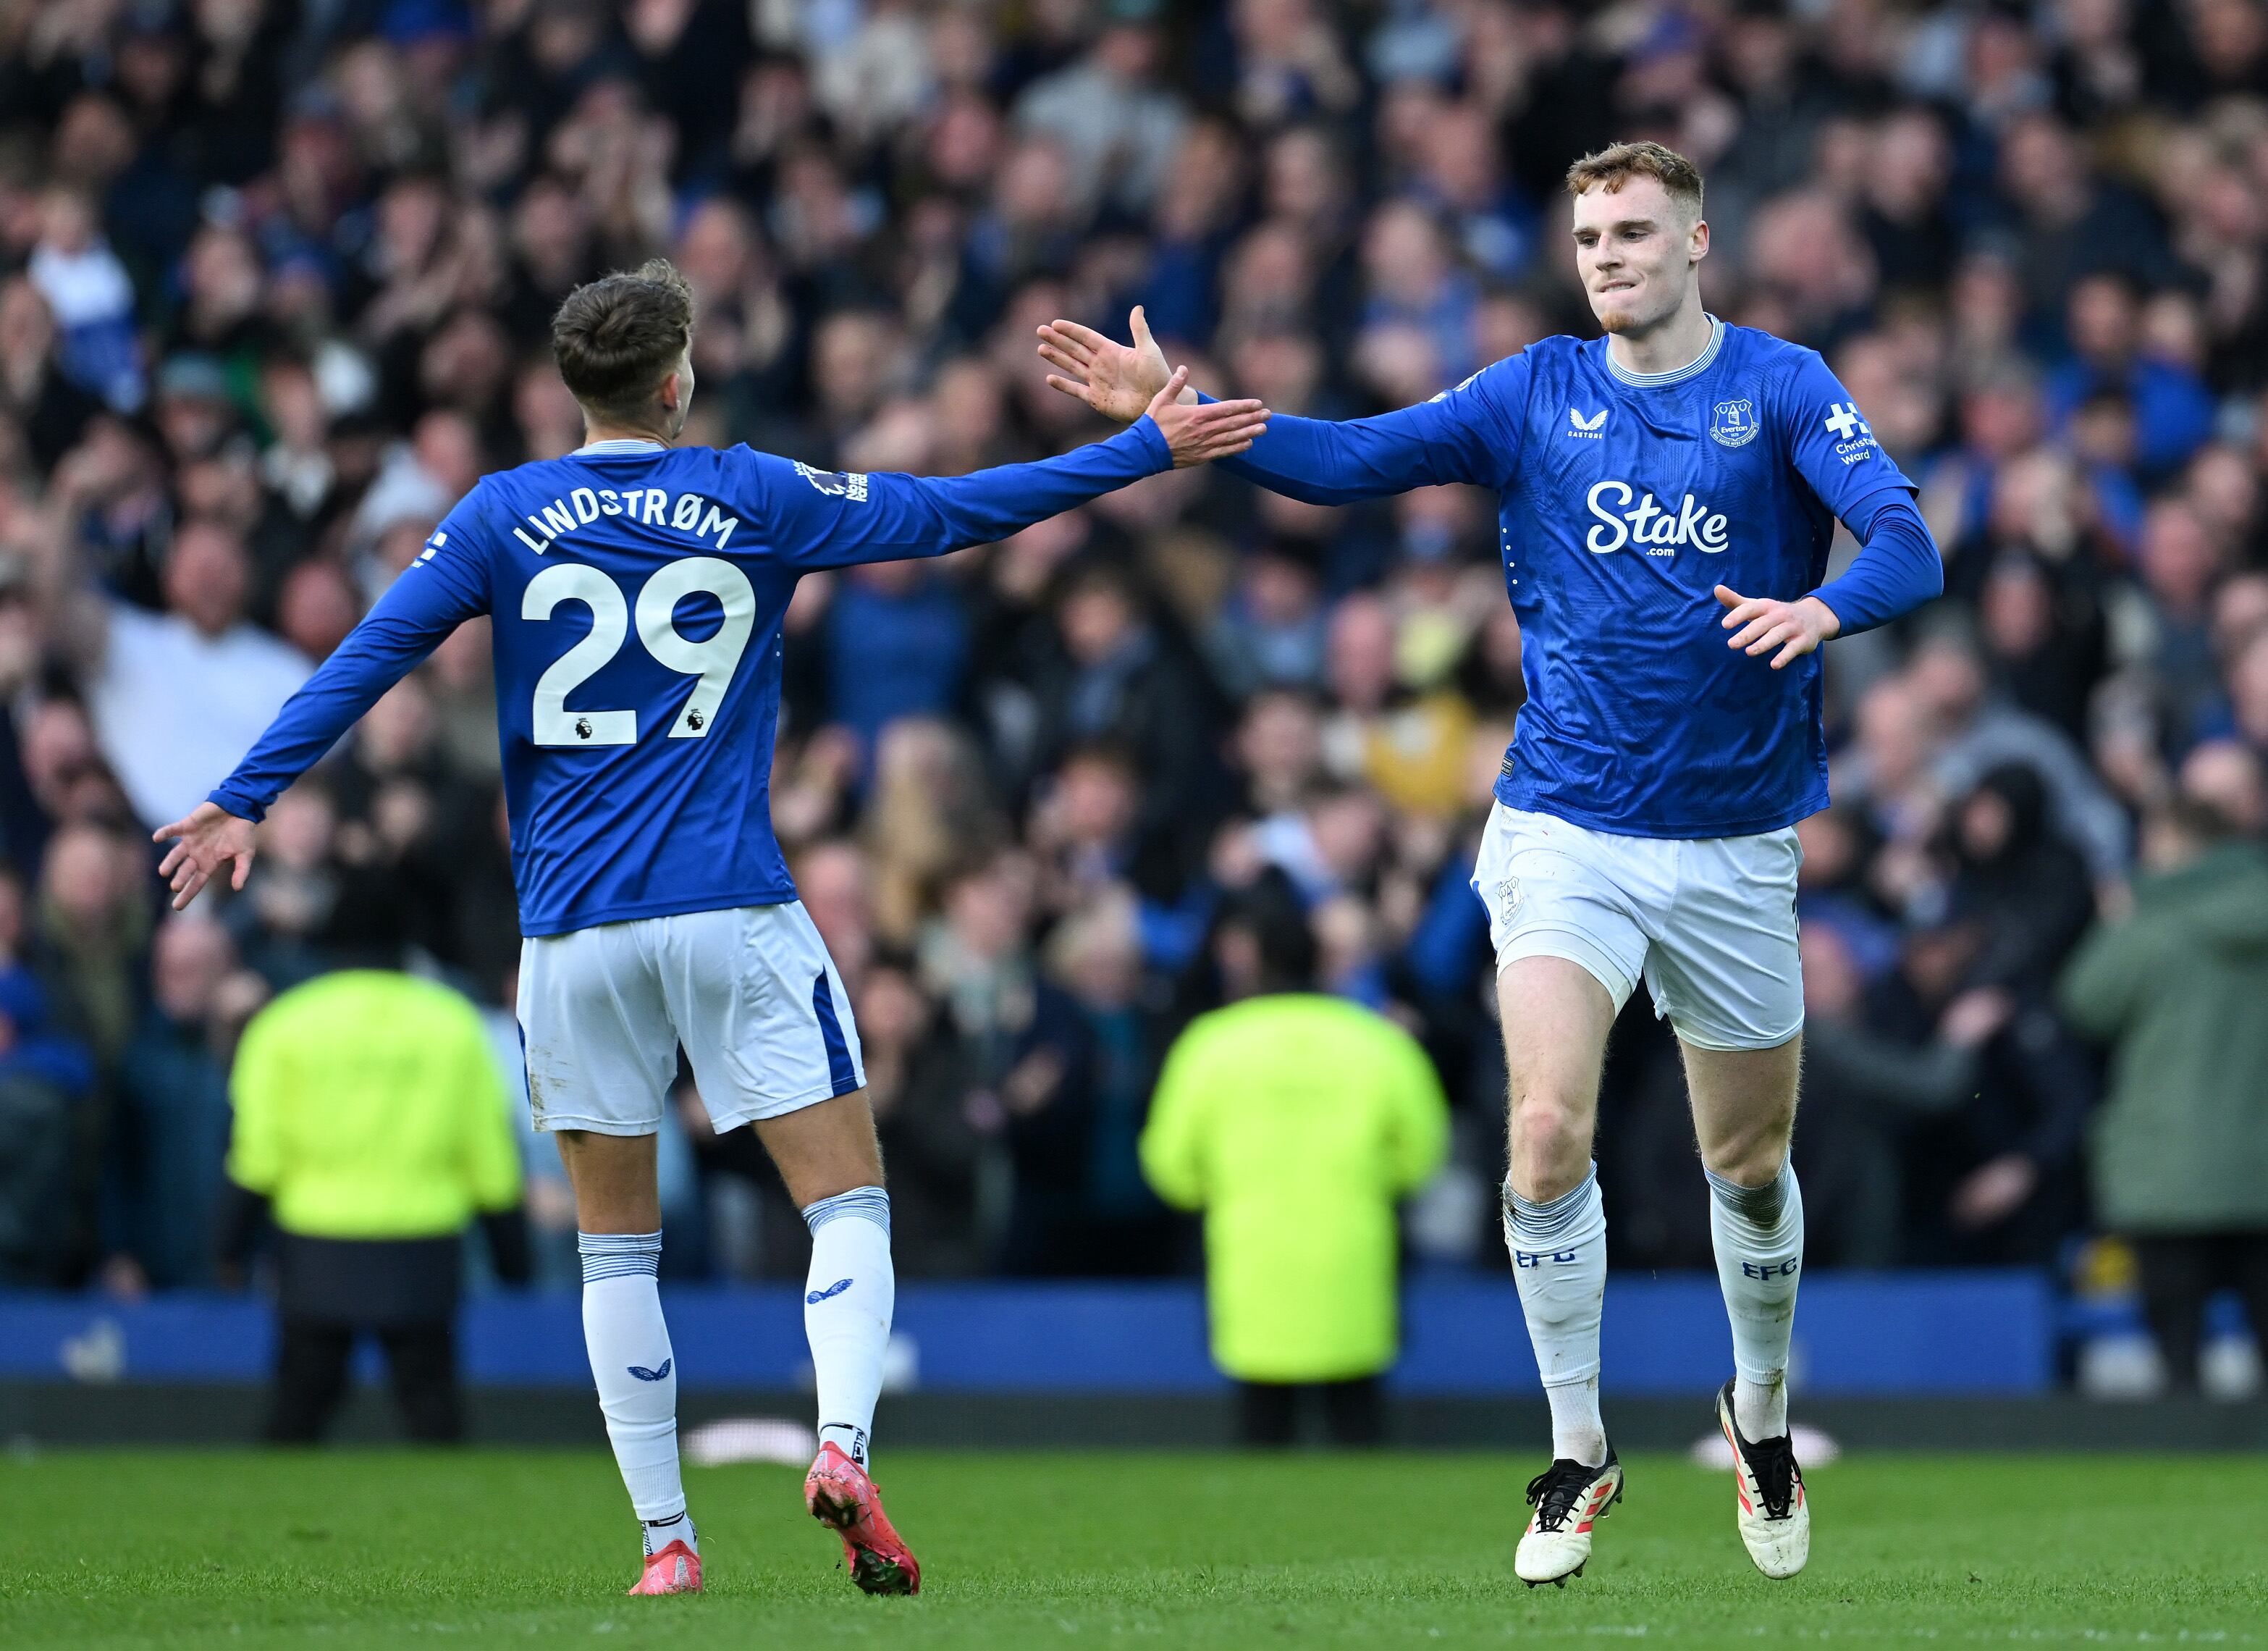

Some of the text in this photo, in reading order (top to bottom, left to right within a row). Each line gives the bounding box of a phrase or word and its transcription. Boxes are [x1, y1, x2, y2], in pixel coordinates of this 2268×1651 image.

[1841, 448, 1870, 465] Ward
[513, 487, 739, 555] LINDSTRØM
[1587, 481, 1729, 554] Stake
[1646, 547, 1675, 557] .com
[521, 556, 756, 746] 29
[1742, 1256, 1797, 1280] EFC
